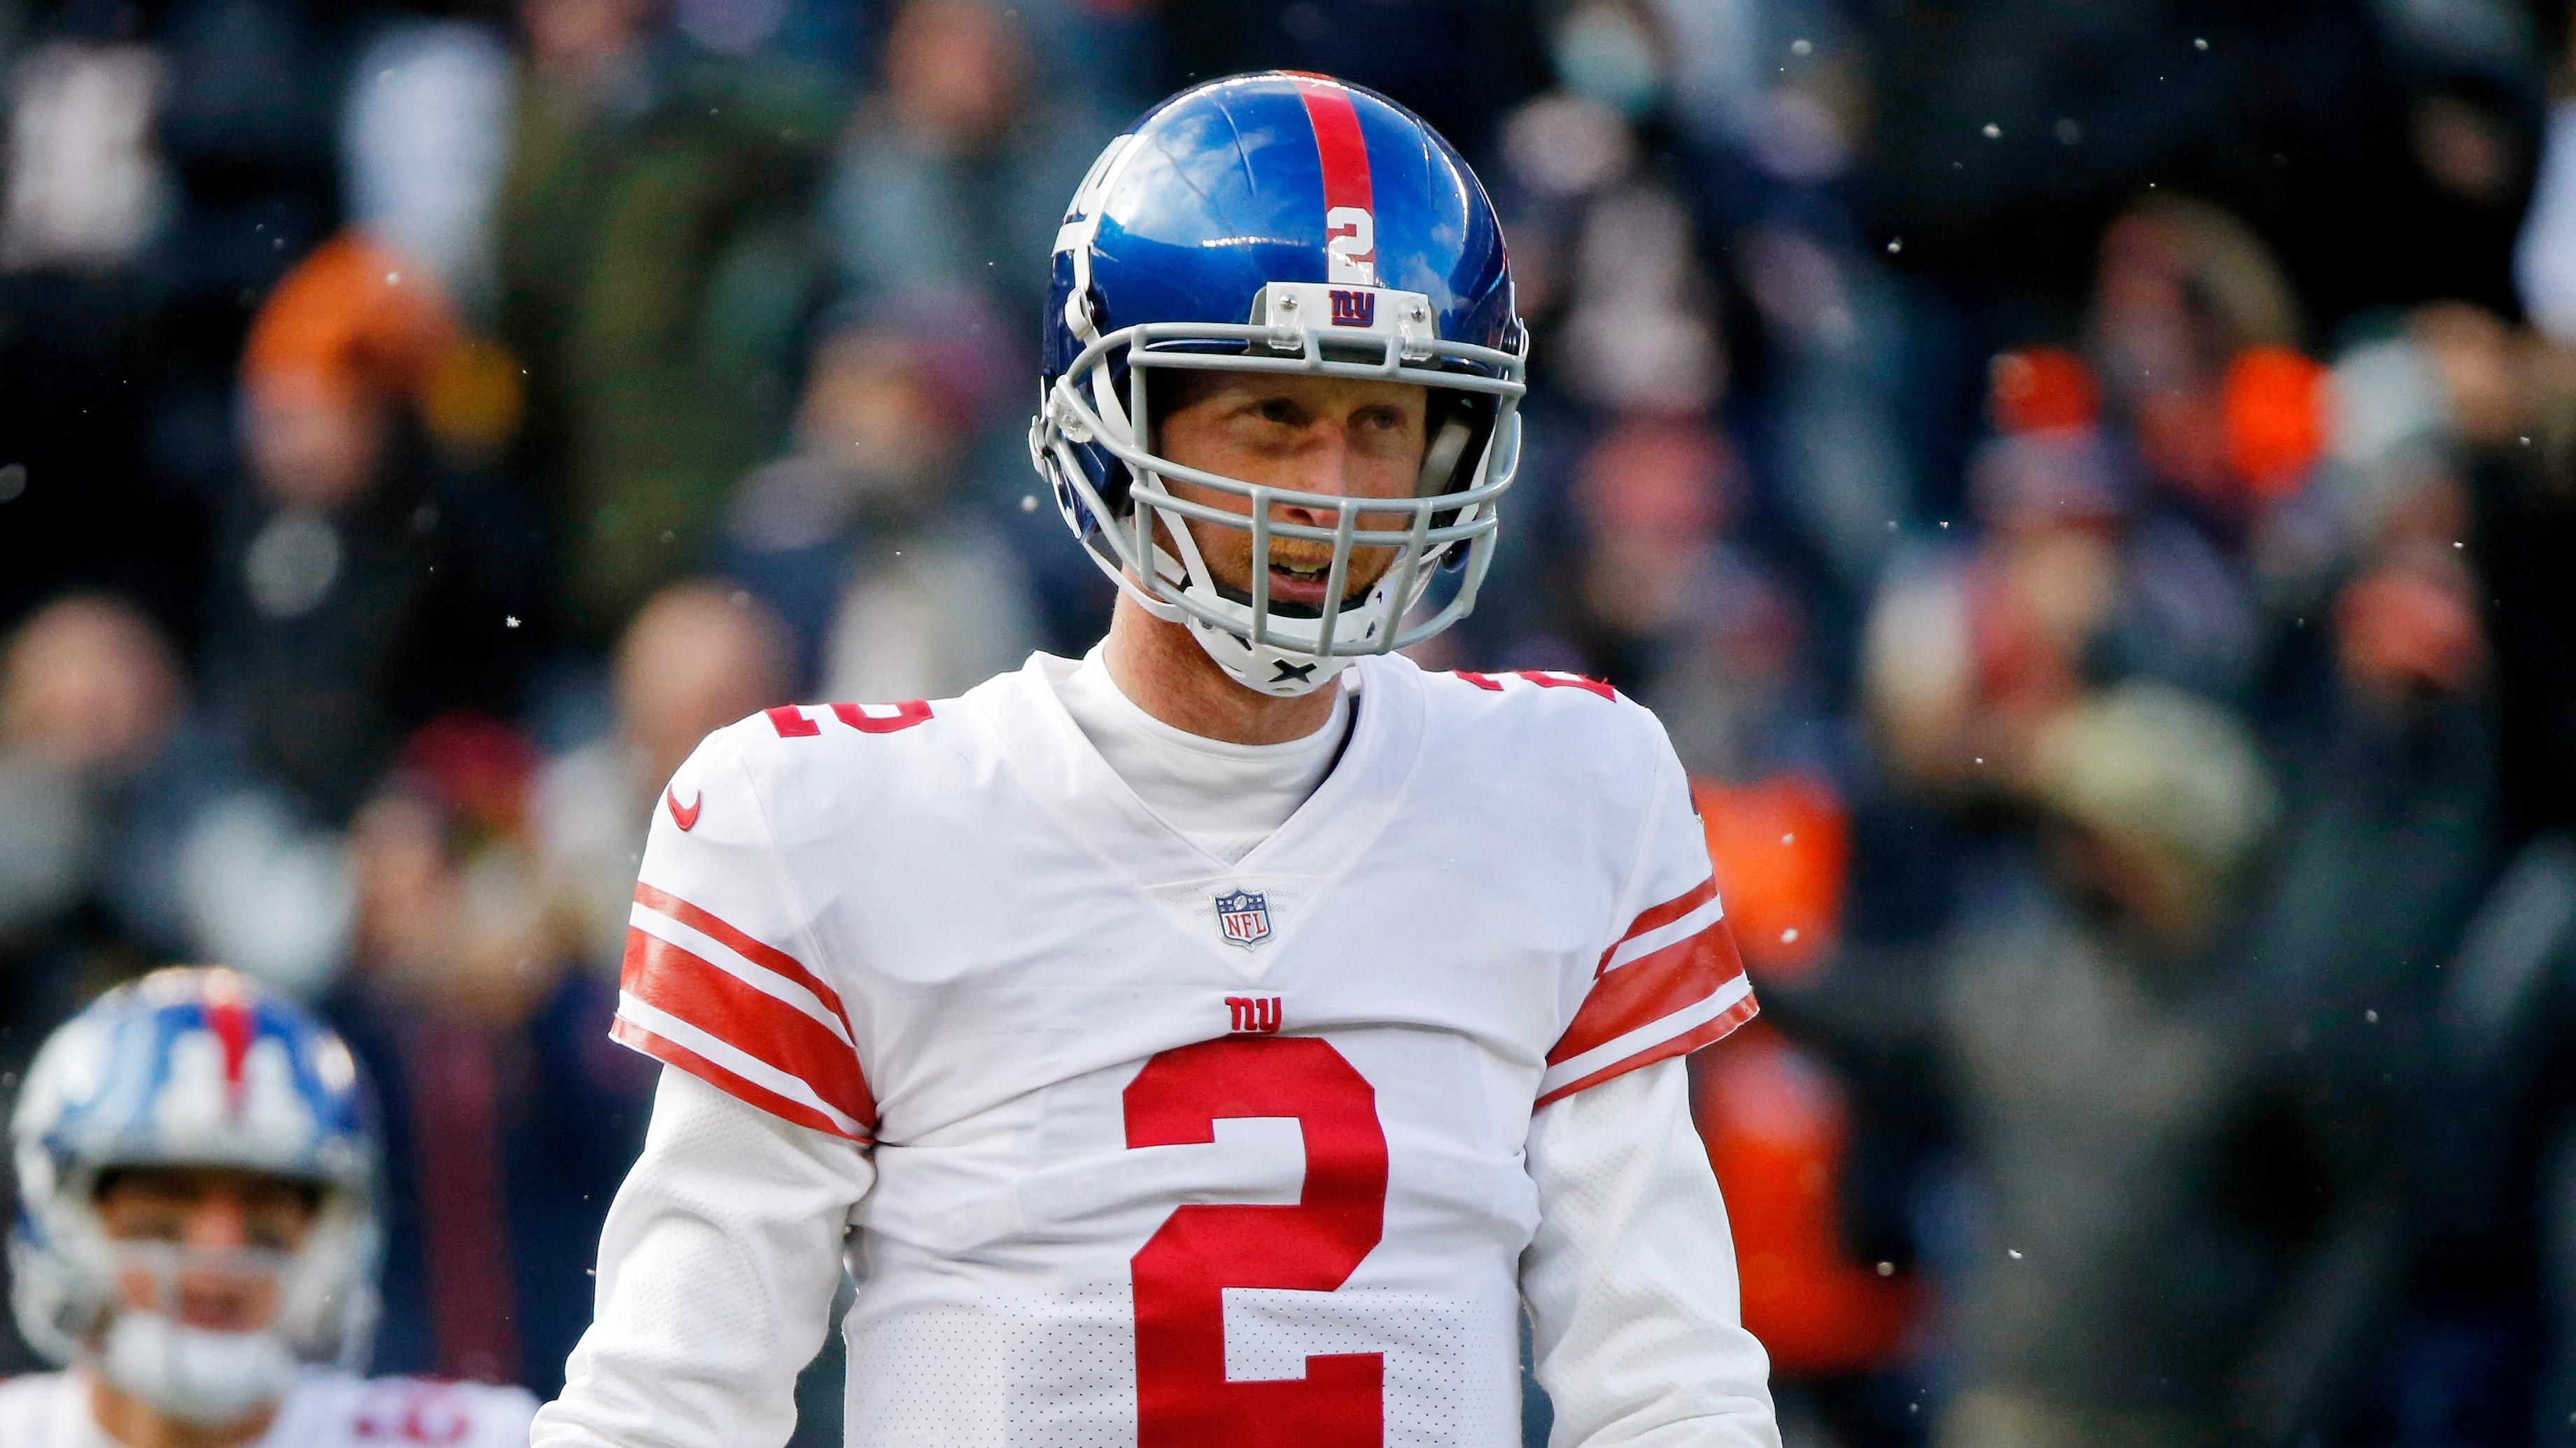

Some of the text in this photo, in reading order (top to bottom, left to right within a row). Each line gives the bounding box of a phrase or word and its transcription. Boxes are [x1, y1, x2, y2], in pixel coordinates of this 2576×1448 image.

[1326, 206, 1373, 284] 2
[1226, 913, 1267, 938] NFL
[1123, 1035, 1389, 1448] 2
